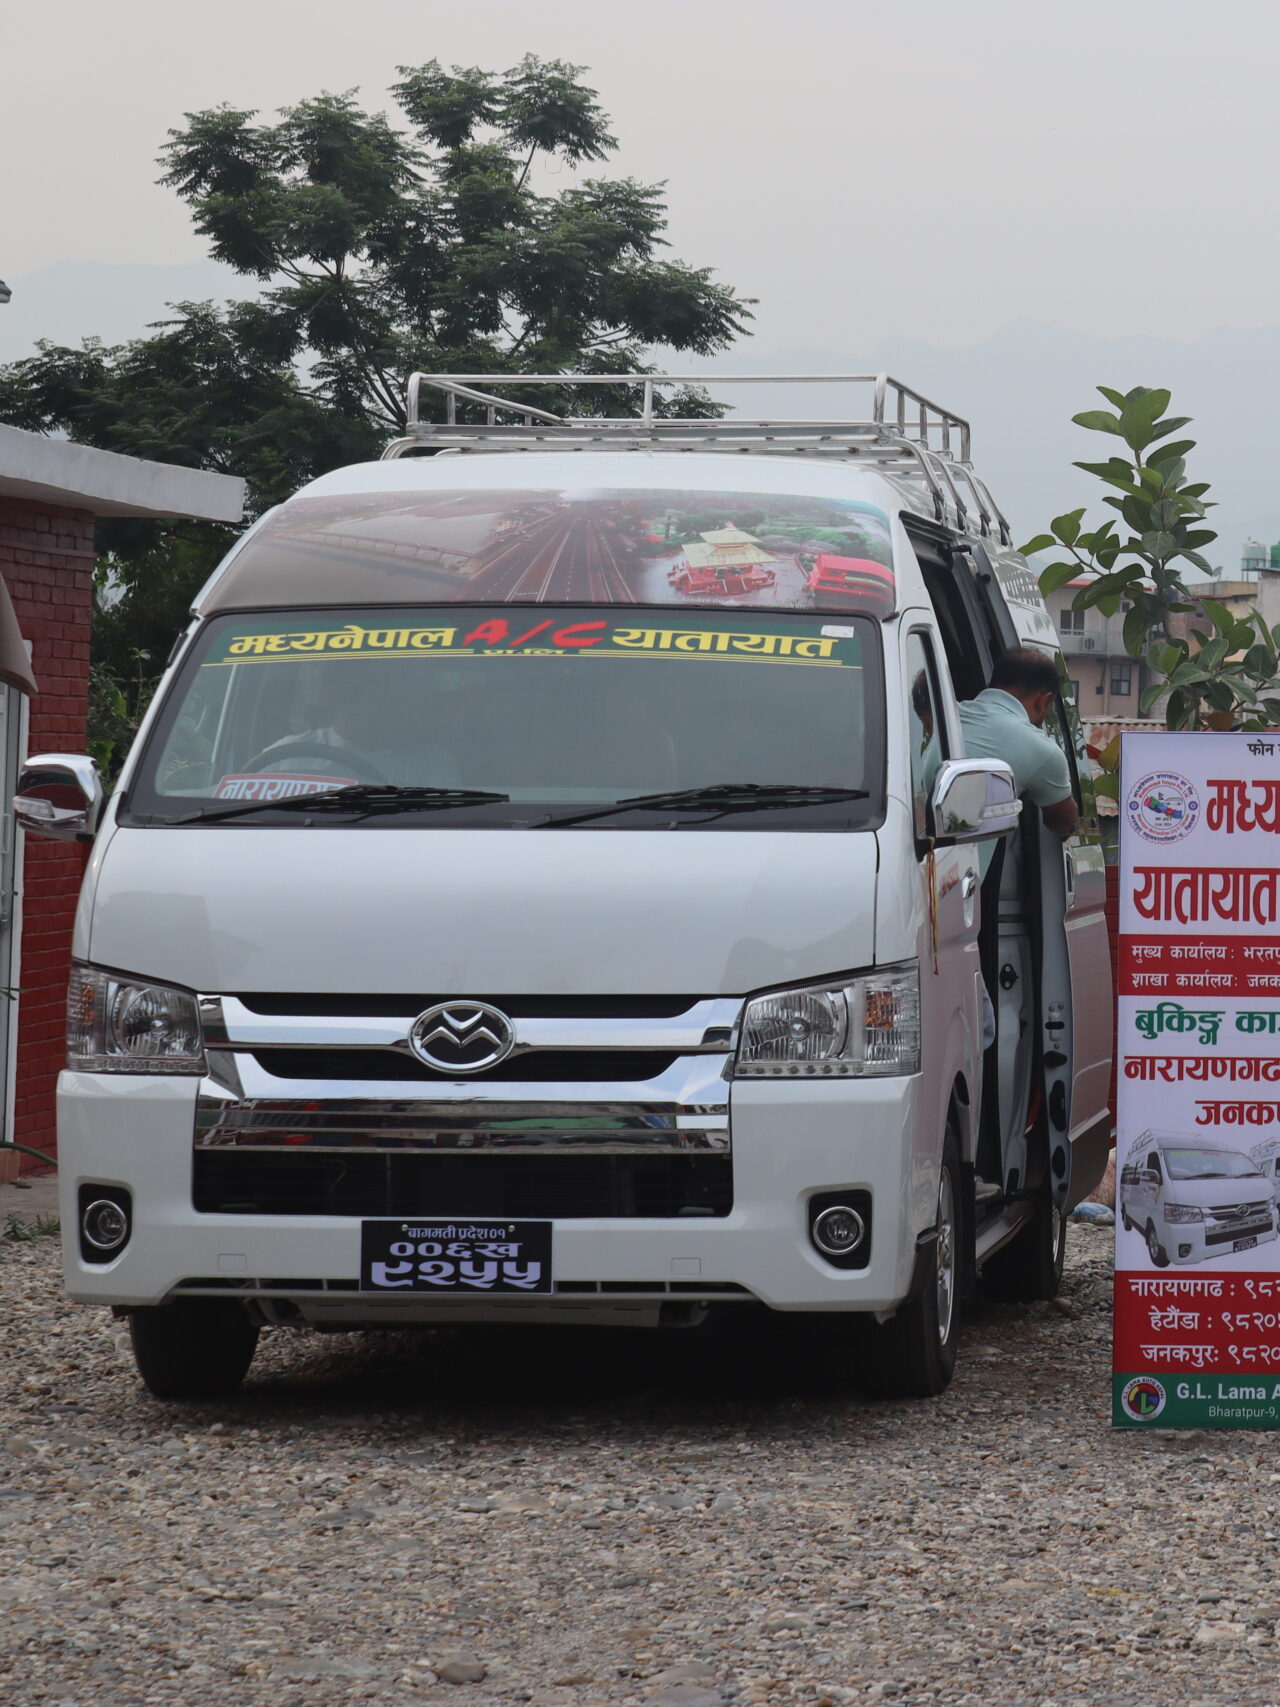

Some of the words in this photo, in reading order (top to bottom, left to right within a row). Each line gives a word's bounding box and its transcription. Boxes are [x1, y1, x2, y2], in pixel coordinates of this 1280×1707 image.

[228, 626, 458, 654] मध्यनेपाल
[461, 619, 607, 648] A/C
[612, 627, 839, 657] यातायात
[1247, 739, 1274, 756] फोन
[1133, 866, 1280, 926] यातायात
[1131, 944, 1163, 964] मुख्य
[1131, 972, 1169, 988] शाखा
[408, 1225, 456, 1239] बागमती
[458, 1225, 488, 1240] प्रदेश
[1176, 1383, 1212, 1400] G.L.
[1218, 1383, 1267, 1400] Lama
[1208, 1406, 1279, 1420] Bharatpur-9,
